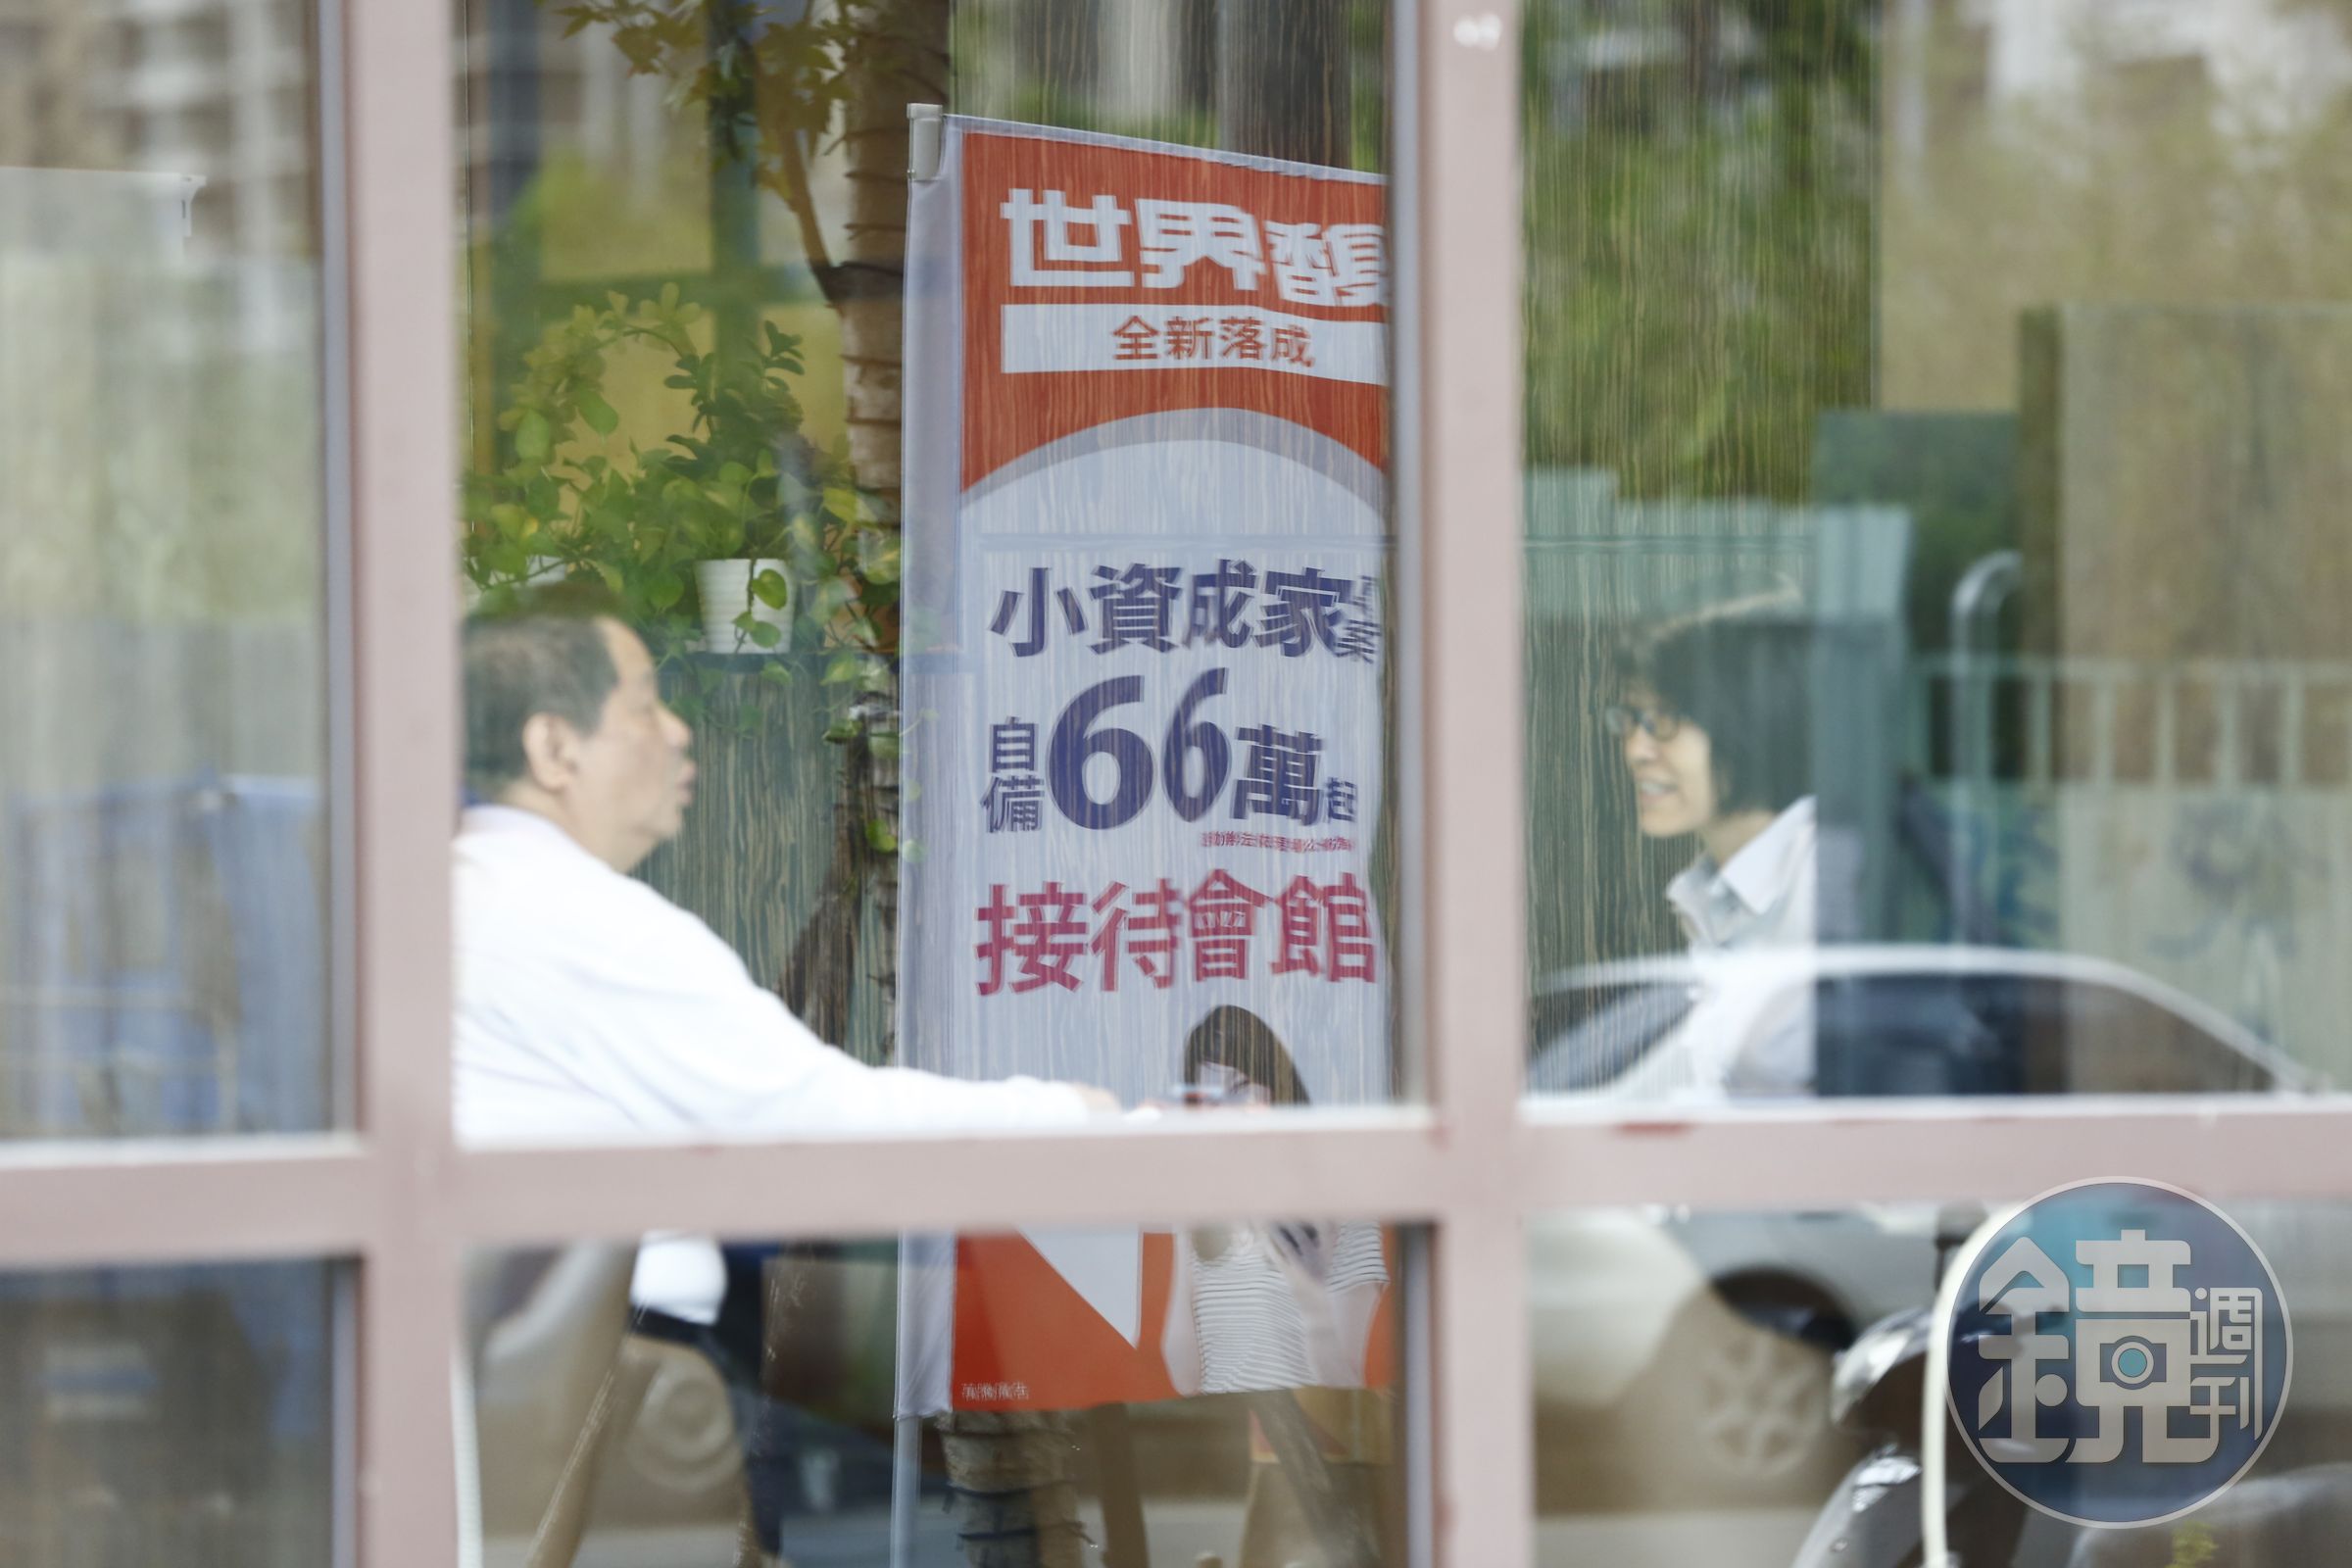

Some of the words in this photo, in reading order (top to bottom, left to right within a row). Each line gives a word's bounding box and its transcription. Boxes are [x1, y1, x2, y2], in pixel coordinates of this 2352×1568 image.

[1111, 315, 1315, 368] 全新落成
[974, 868, 1377, 997] 接待會館
